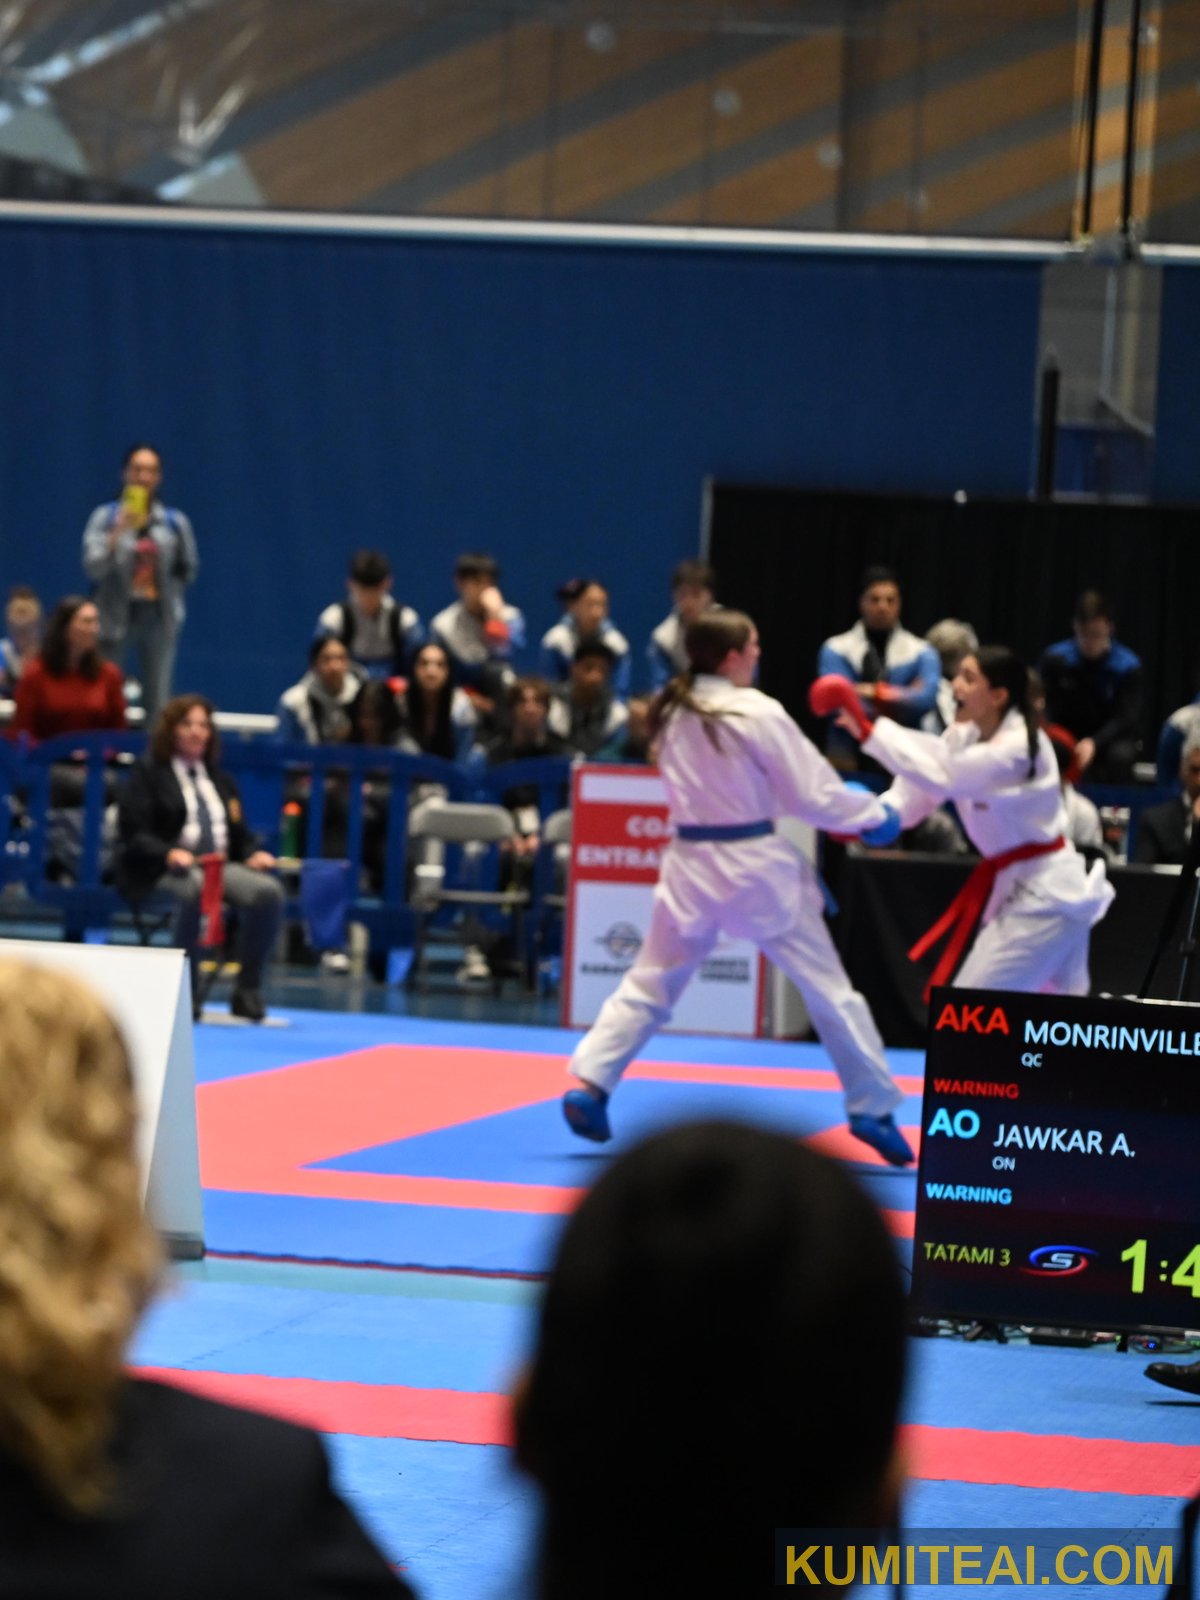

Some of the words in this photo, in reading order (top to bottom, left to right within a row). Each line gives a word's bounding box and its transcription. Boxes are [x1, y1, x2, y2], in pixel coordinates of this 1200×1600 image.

[935, 1003, 1010, 1035] AKA
[1020, 1052, 1043, 1068] QC
[933, 1077, 1020, 1099] WARNING
[927, 1107, 981, 1139] AO
[993, 1123, 1104, 1156] JAWKAR
[1110, 1132, 1136, 1158] A.
[991, 1155, 1016, 1171] ON
[925, 1182, 1013, 1205] WARNING
[923, 1242, 995, 1265] TATAMI
[999, 1248, 1011, 1267] 3
